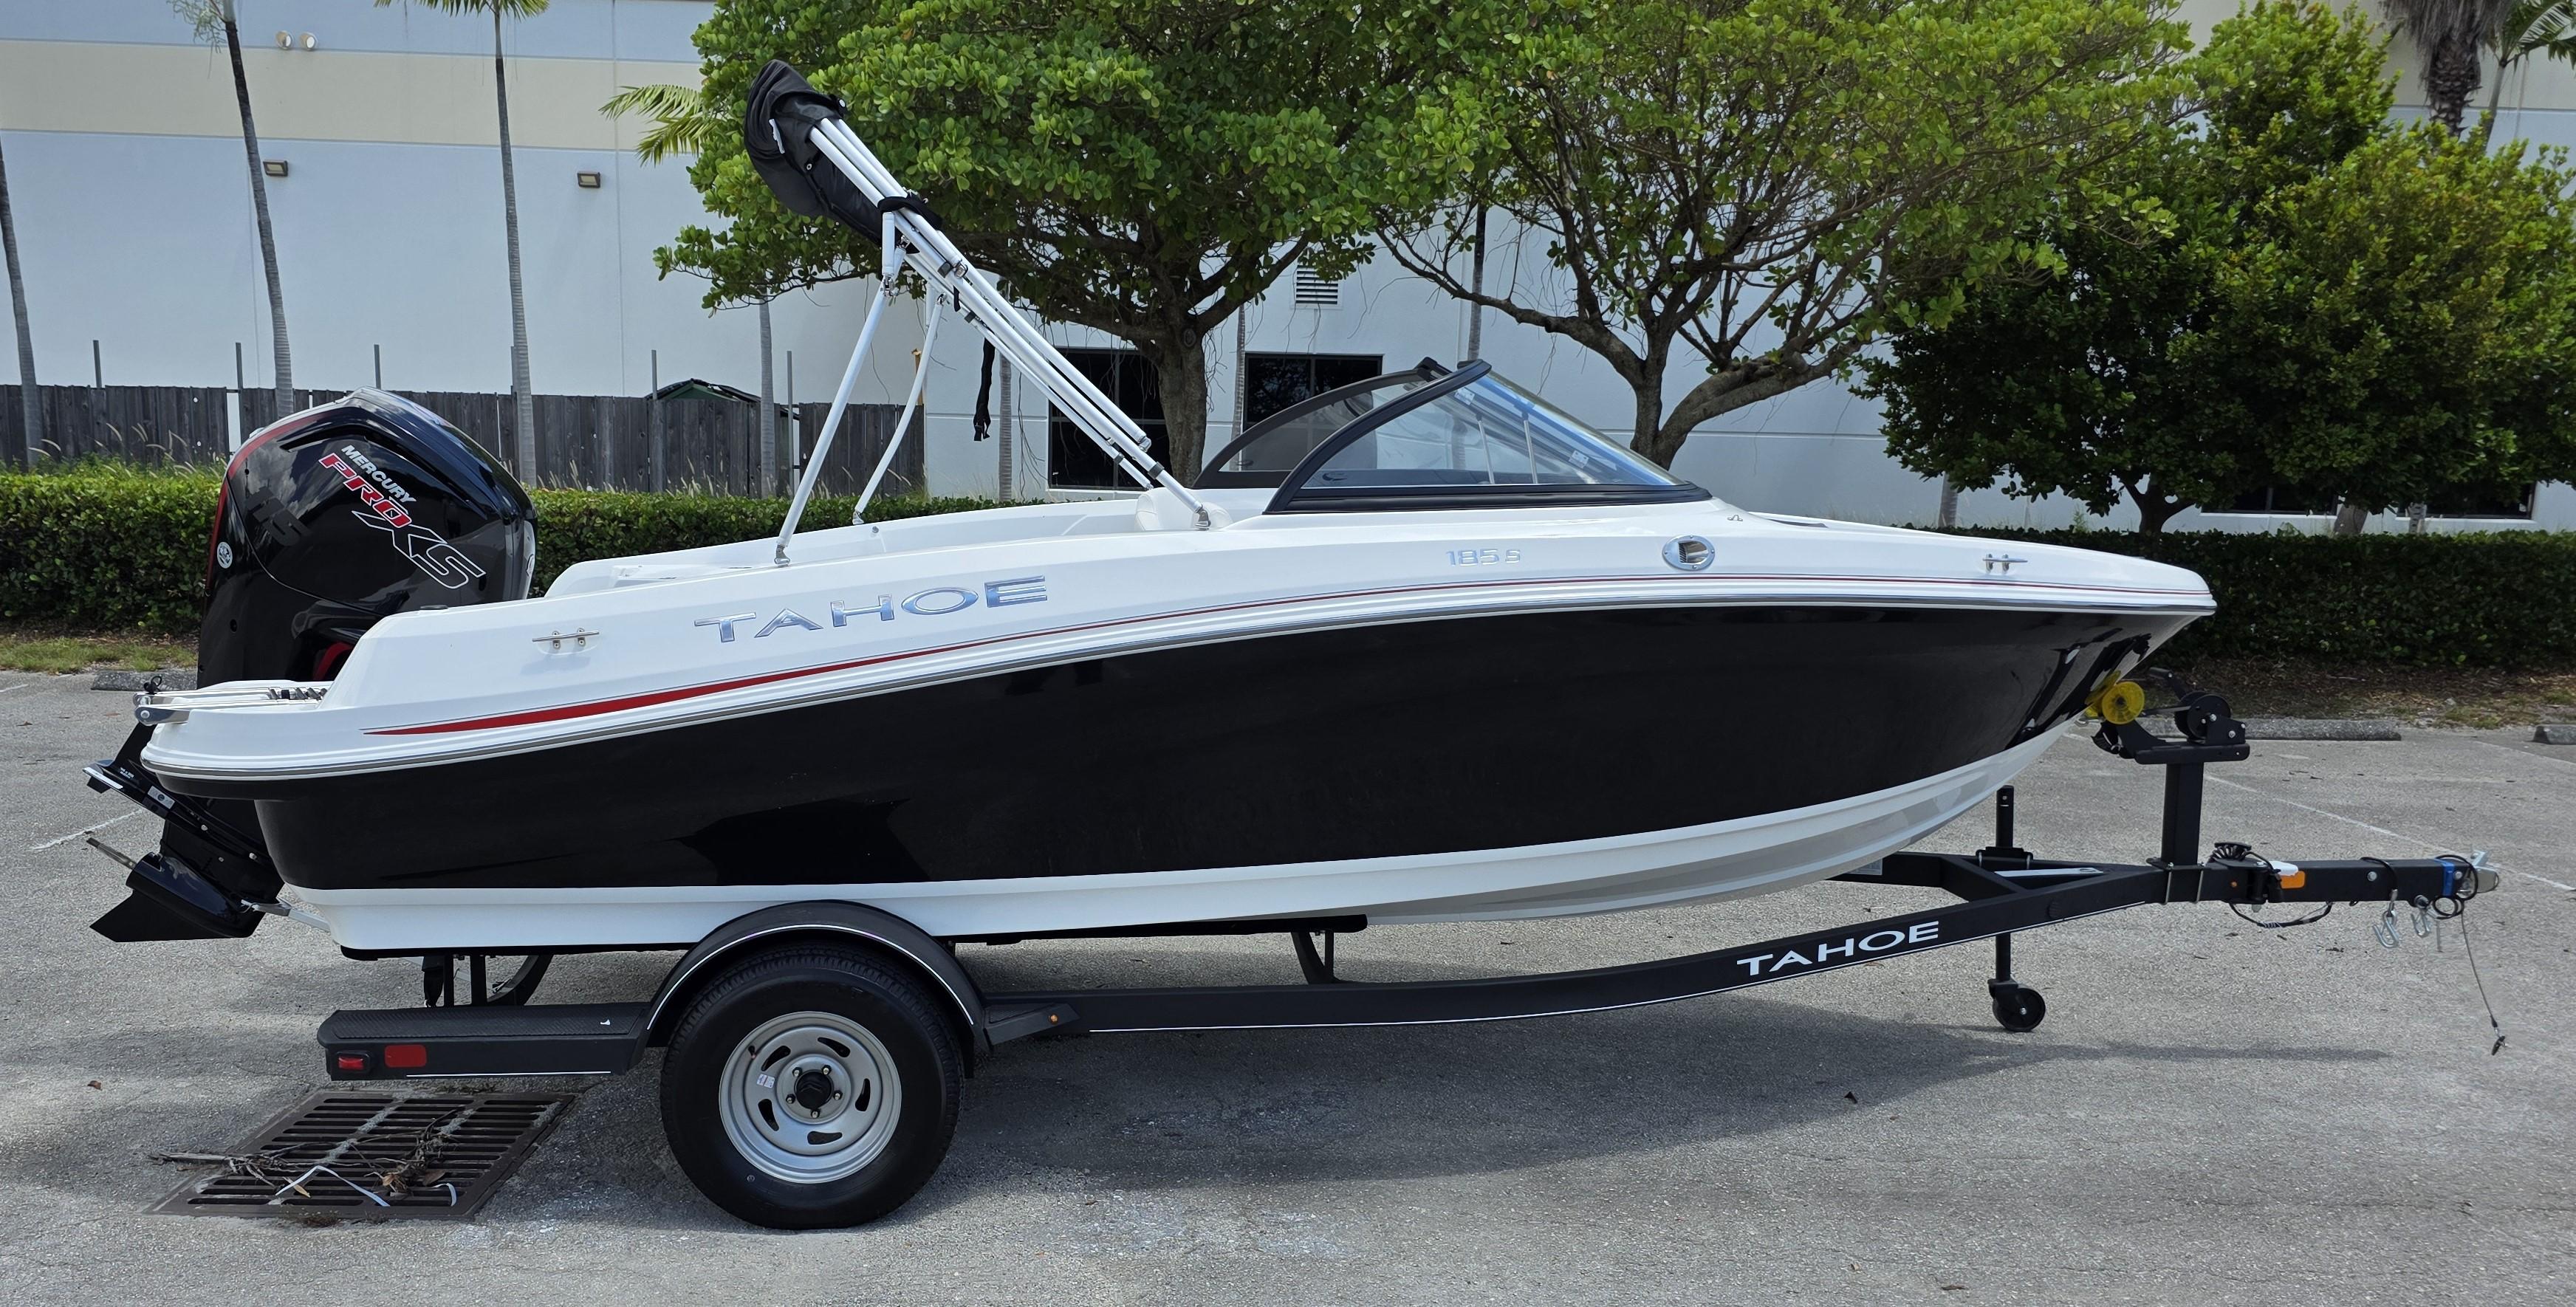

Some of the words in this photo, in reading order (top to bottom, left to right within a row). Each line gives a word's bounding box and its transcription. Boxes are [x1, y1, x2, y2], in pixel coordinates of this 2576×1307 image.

[318, 453, 412, 528] PRO
[341, 445, 417, 502] MERCURY
[247, 486, 313, 546] 115
[352, 496, 487, 589] XS
[1446, 549, 1499, 566] 185
[1505, 549, 1521, 563] S
[694, 574, 1048, 643] TAHOE
[1736, 921, 1939, 976] TAHOE
